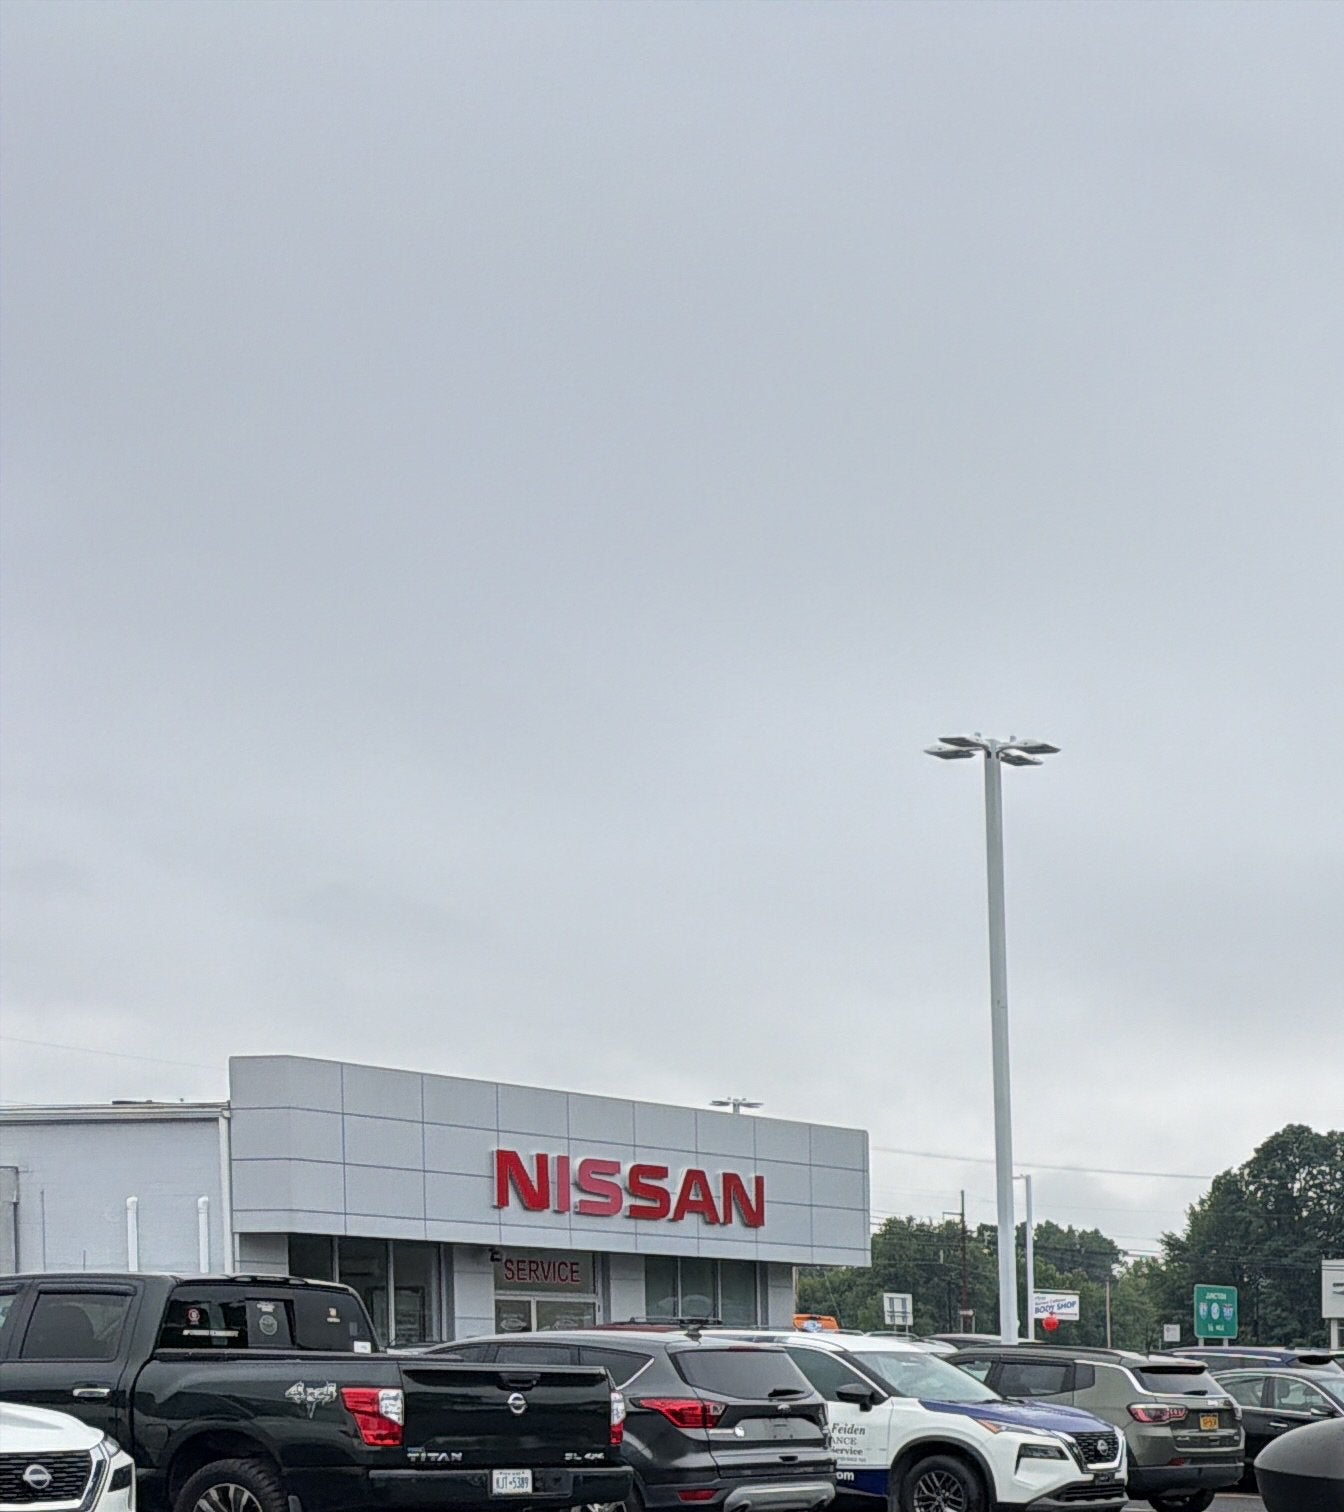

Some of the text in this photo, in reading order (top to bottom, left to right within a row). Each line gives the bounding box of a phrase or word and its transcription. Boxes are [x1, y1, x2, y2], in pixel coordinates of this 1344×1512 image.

[495, 1148, 766, 1228] NISSAN
[504, 1259, 580, 1284] SERVICE
[831, 1423, 866, 1436] Feiden
[407, 1452, 463, 1462] TITAN
